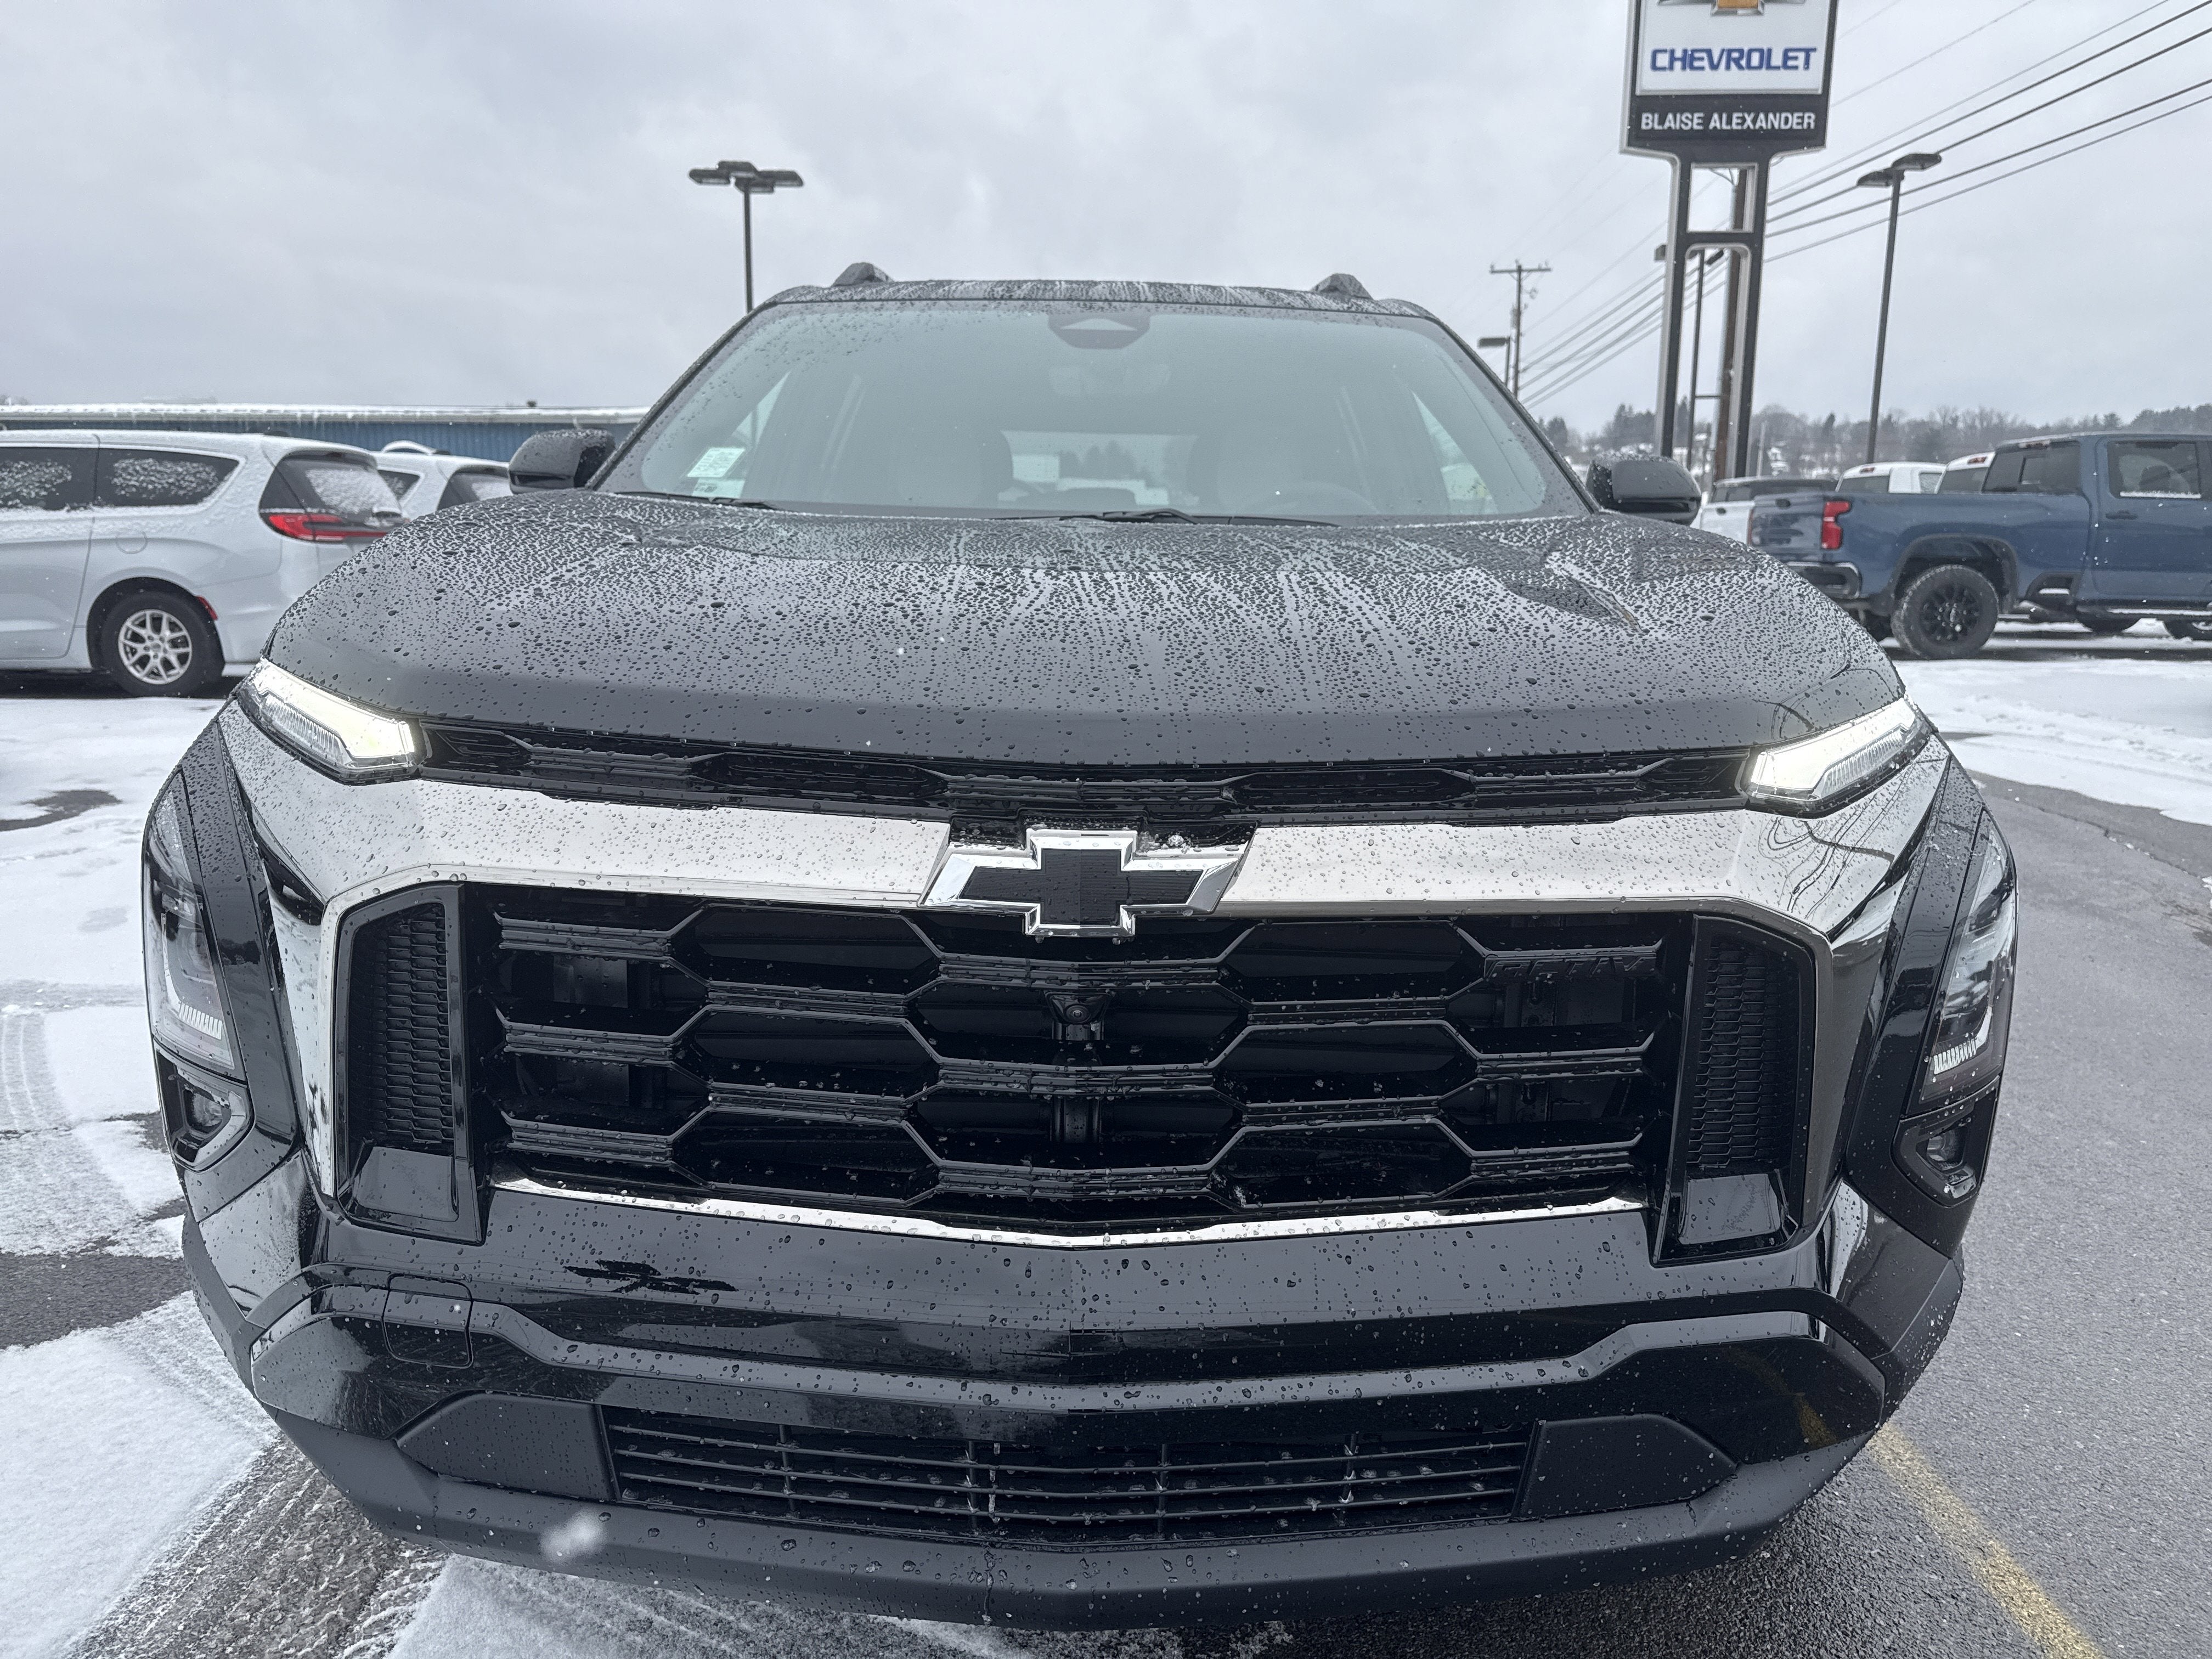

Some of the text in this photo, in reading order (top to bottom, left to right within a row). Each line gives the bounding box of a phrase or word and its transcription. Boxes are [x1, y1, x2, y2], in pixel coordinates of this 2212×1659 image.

[1650, 48, 1816, 71] CHEVROLET
[1641, 112, 1815, 130] BLAISE ALEXANDER
